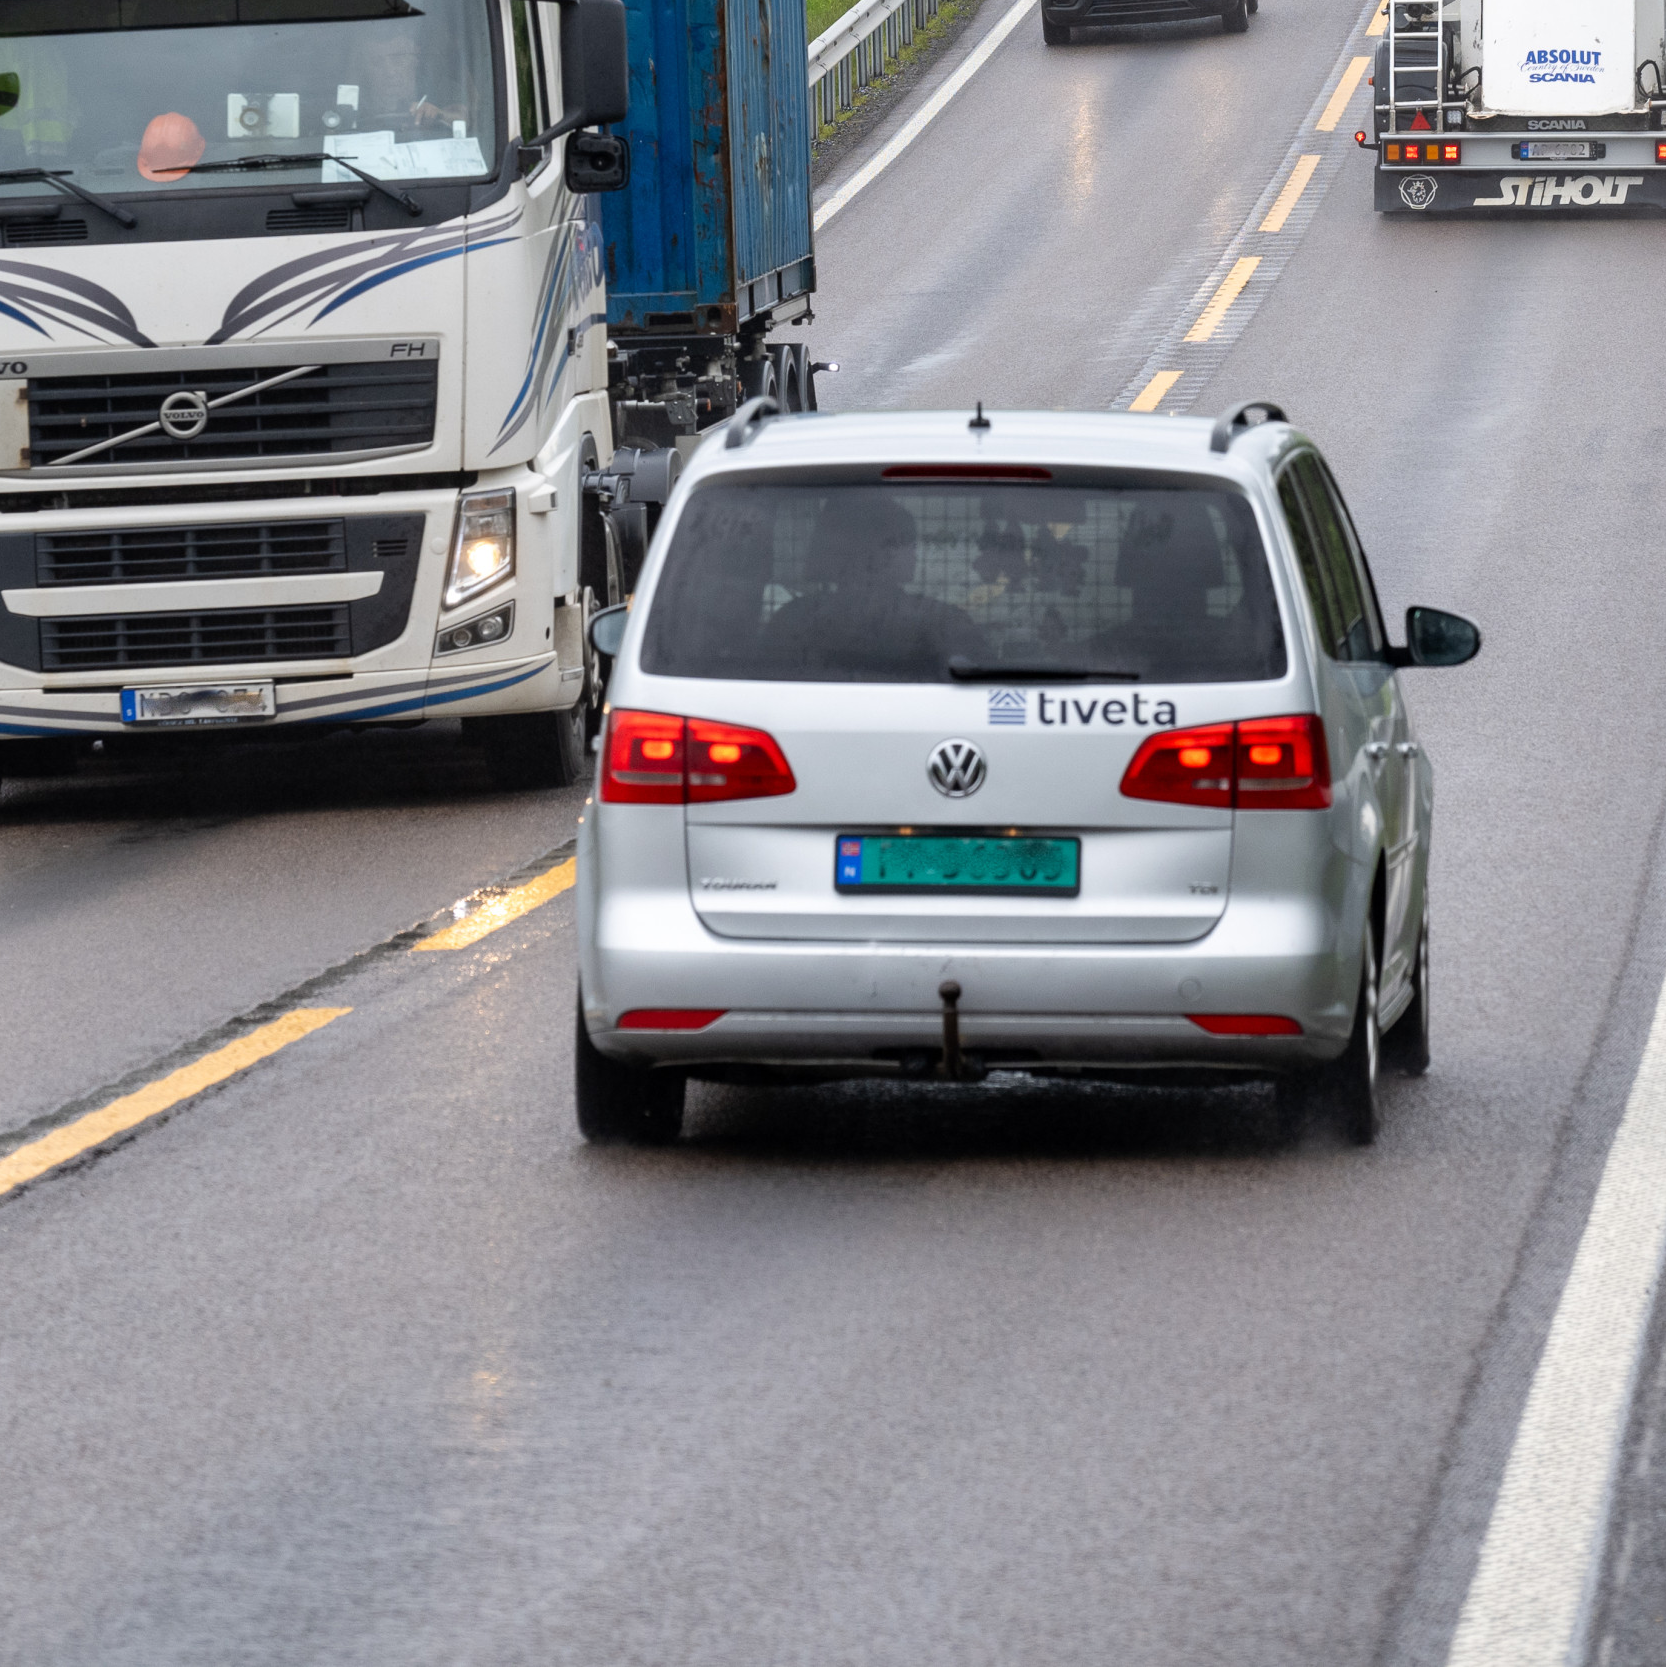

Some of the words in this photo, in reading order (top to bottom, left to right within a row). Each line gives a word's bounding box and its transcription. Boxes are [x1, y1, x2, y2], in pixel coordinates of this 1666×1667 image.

[1526, 49, 1601, 66] ABSOLUT
[1517, 60, 1558, 74] Country
[1529, 72, 1596, 84] SCANIA
[1527, 119, 1587, 130] SCANIA
[390, 342, 425, 358] FH
[163, 411, 204, 420] VOLVO
[1038, 692, 1176, 726] tiveta
